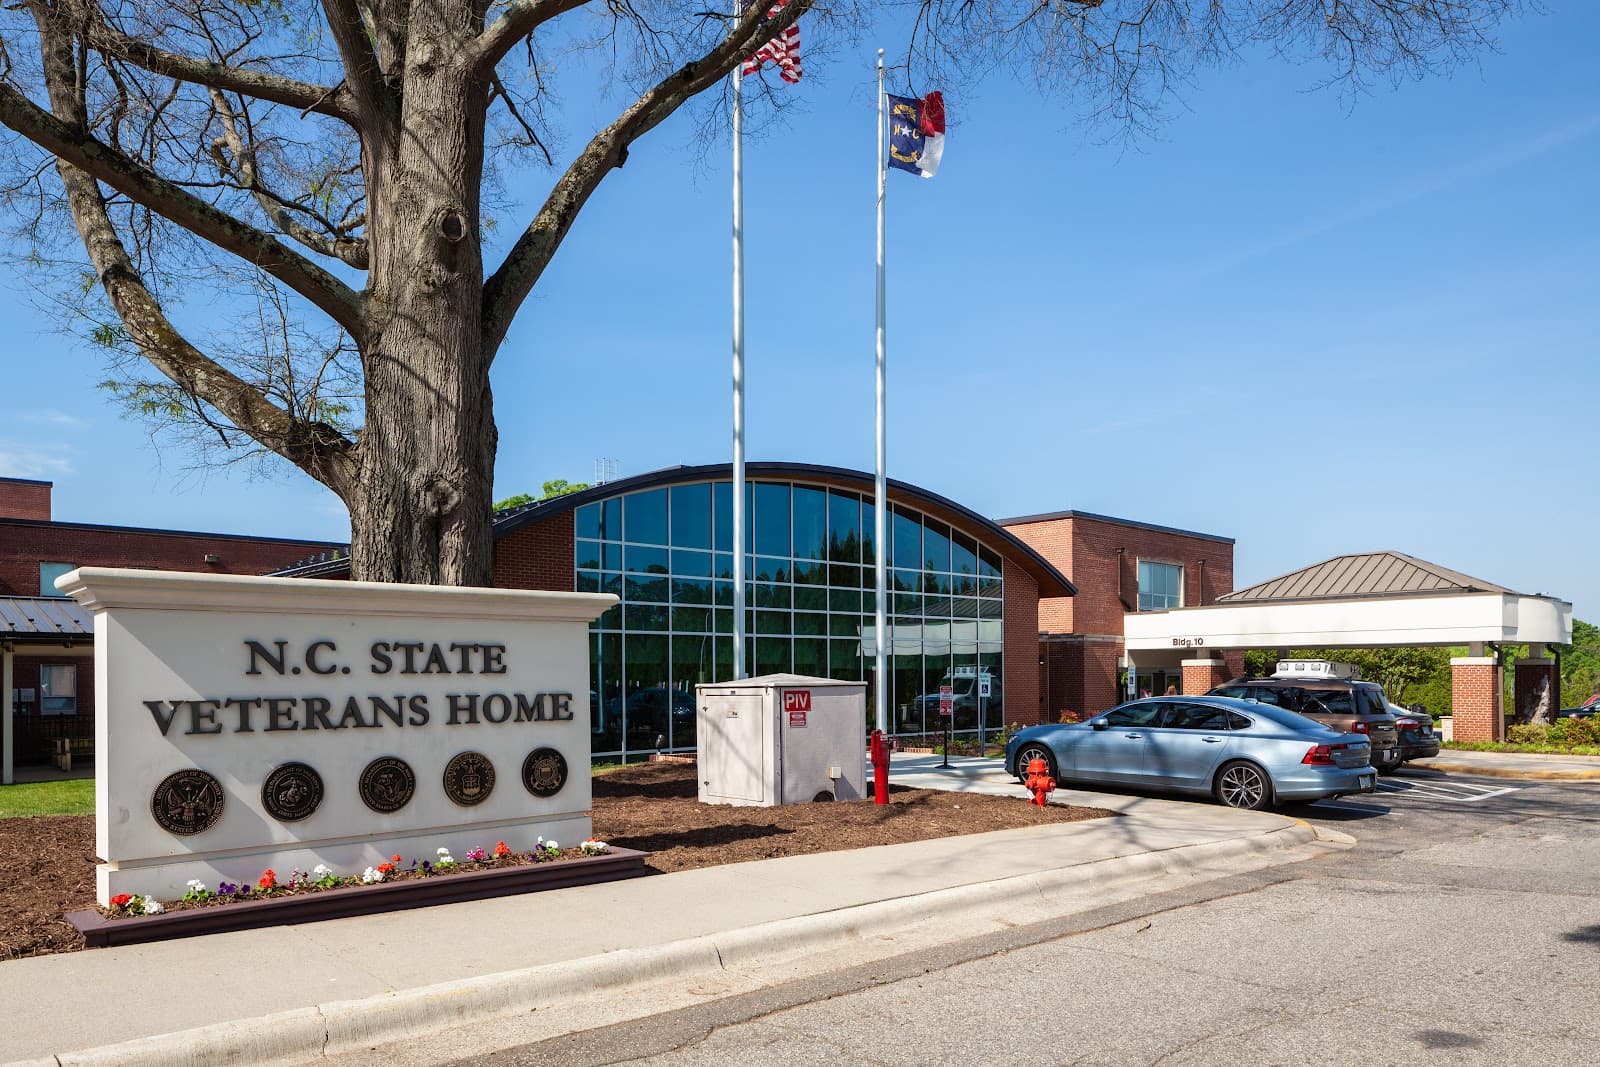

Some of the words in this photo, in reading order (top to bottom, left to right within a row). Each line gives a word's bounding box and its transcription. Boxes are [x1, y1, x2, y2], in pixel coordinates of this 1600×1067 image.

[1173, 637, 1193, 648] Bldg.
[1194, 637, 1204, 646] 10
[243, 639, 351, 676] N.C.
[371, 641, 508, 675] STATE
[786, 693, 808, 708] PIV
[142, 694, 430, 737] VETERANS
[445, 692, 574, 726] HOME
